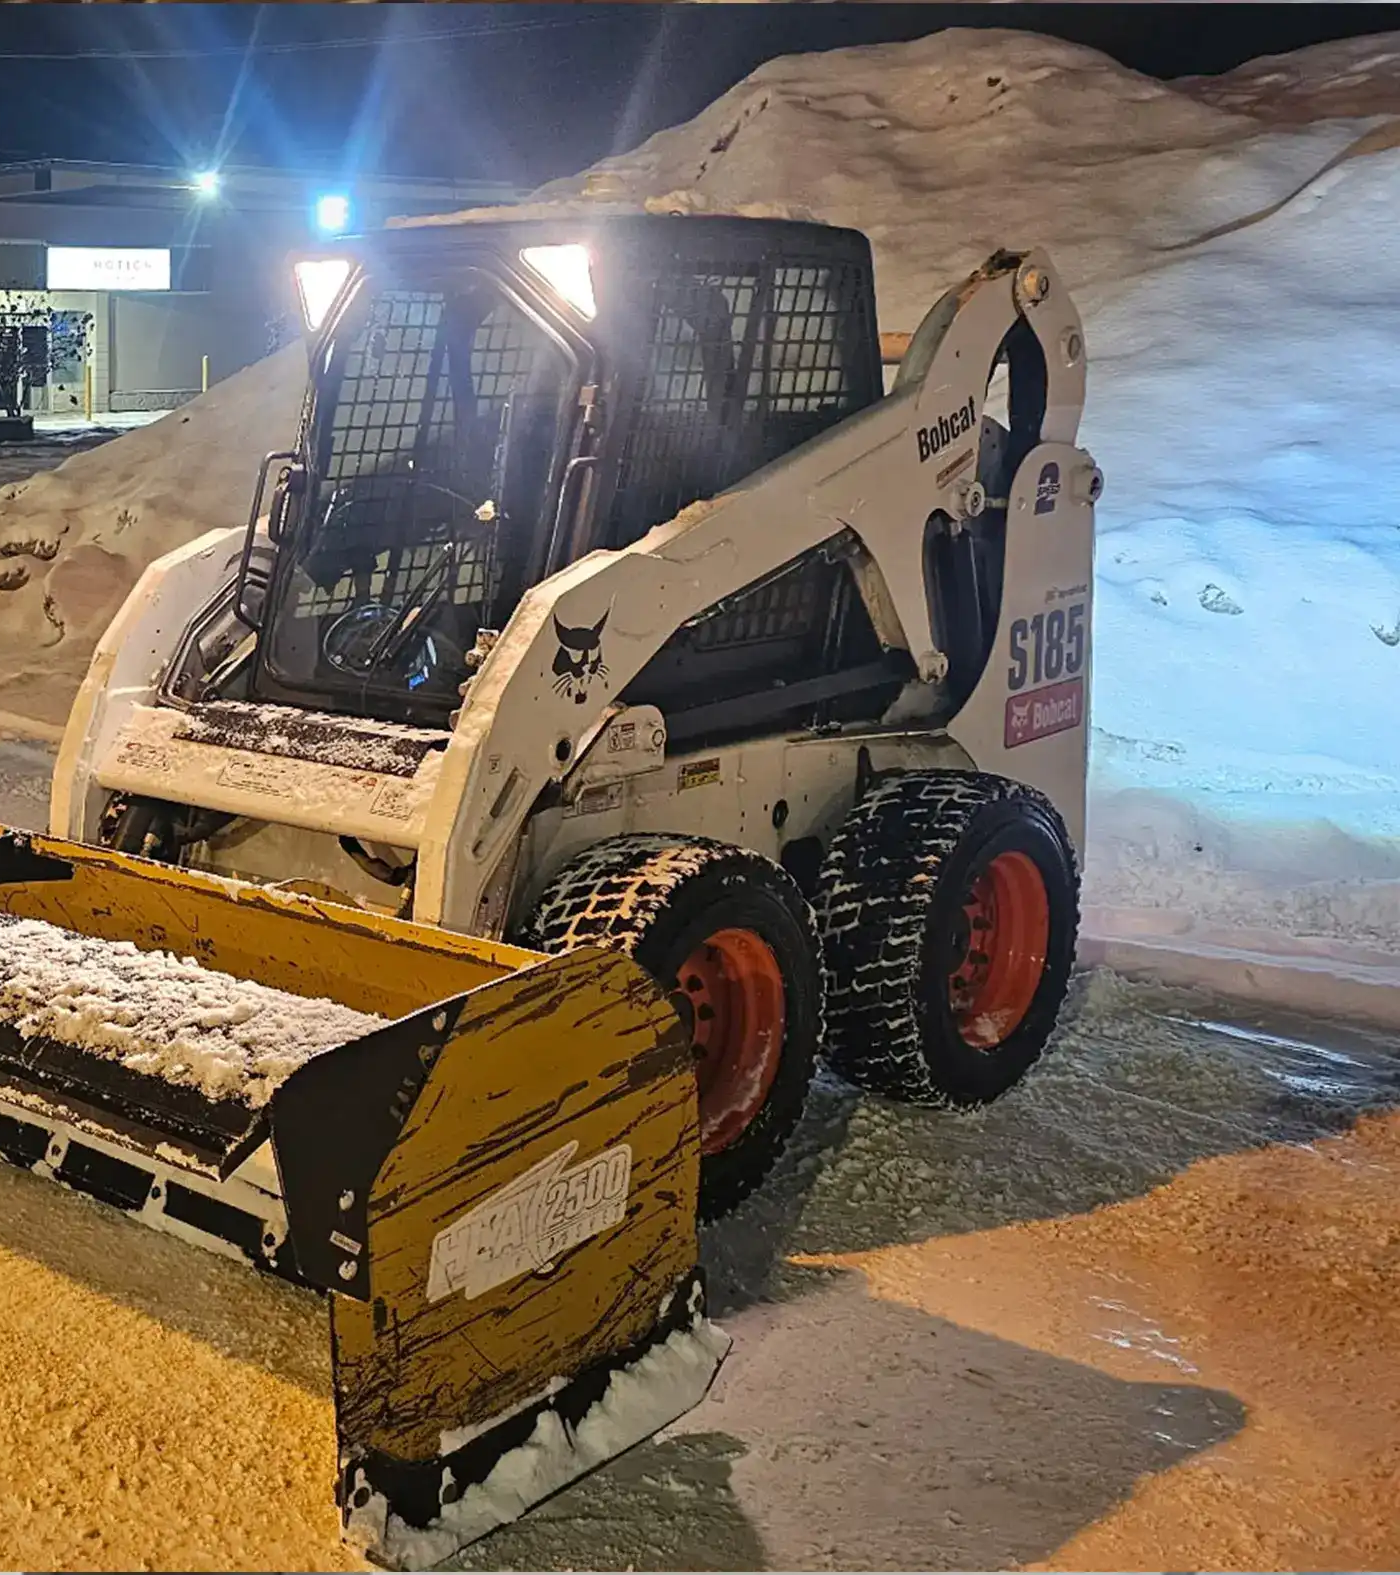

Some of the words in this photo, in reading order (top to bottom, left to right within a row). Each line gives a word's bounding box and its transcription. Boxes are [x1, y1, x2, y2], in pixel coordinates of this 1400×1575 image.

[916, 395, 976, 463] Bobcat
[1007, 604, 1085, 691] S185
[1032, 692, 1077, 731] Bobcat
[545, 1150, 628, 1226] 2500
